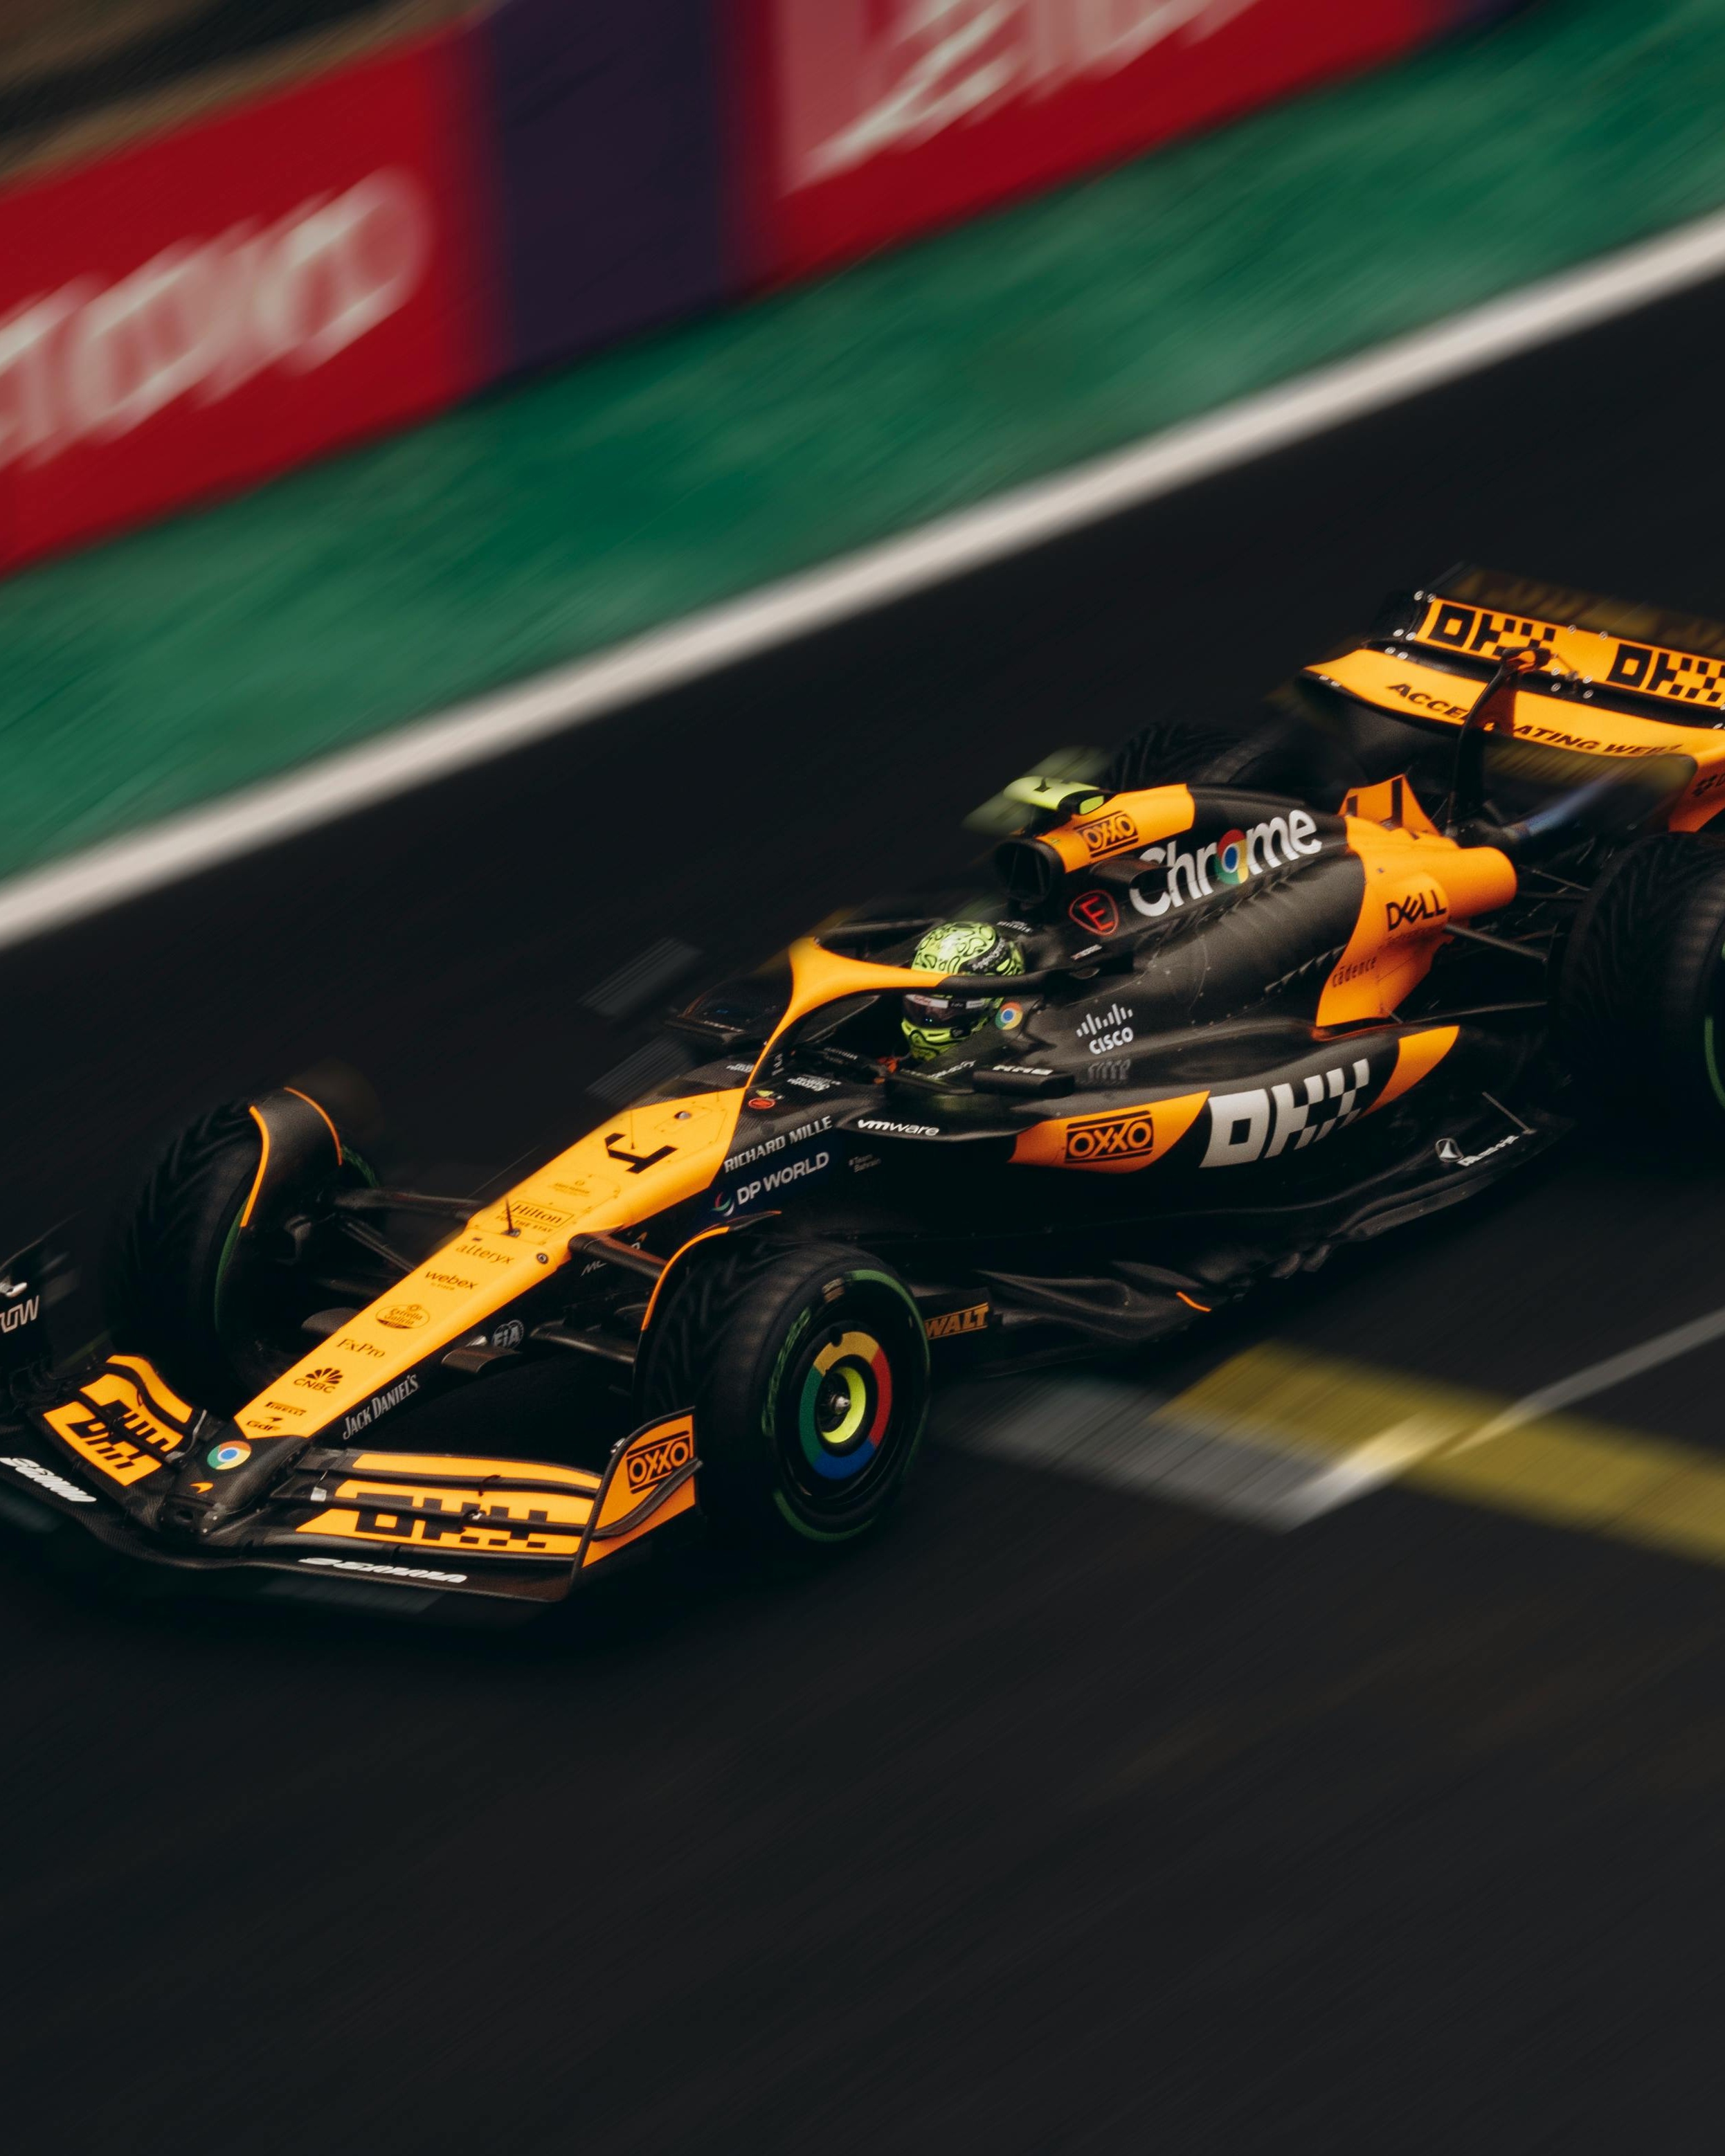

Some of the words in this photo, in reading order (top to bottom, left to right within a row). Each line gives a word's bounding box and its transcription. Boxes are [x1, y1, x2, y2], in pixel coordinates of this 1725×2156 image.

[1389, 682, 1598, 750] ACCEATING
[1083, 814, 1133, 850] OXXO
[1130, 810, 1322, 916] Chrome
[1387, 889, 1447, 932] DELL
[1333, 957, 1377, 988] cadence
[857, 1119, 940, 1136] vmware
[1200, 1059, 1369, 1168] OKX
[724, 1135, 786, 1173] RICHARD
[788, 1115, 833, 1145] MILLE
[1071, 1118, 1153, 1159] OXXO
[737, 1180, 761, 1205] DP
[763, 1152, 830, 1192] WORLD
[512, 1204, 561, 1224] Hilton
[456, 1244, 515, 1265] alteryx
[425, 1271, 479, 1289] webex
[337, 1338, 386, 1357] FxPro
[494, 1323, 523, 1348] FIA
[293, 1378, 336, 1394] CNBC
[343, 1405, 372, 1440] JACK
[371, 1373, 419, 1420] DANIEL'S
[629, 1435, 689, 1489] OXXO
